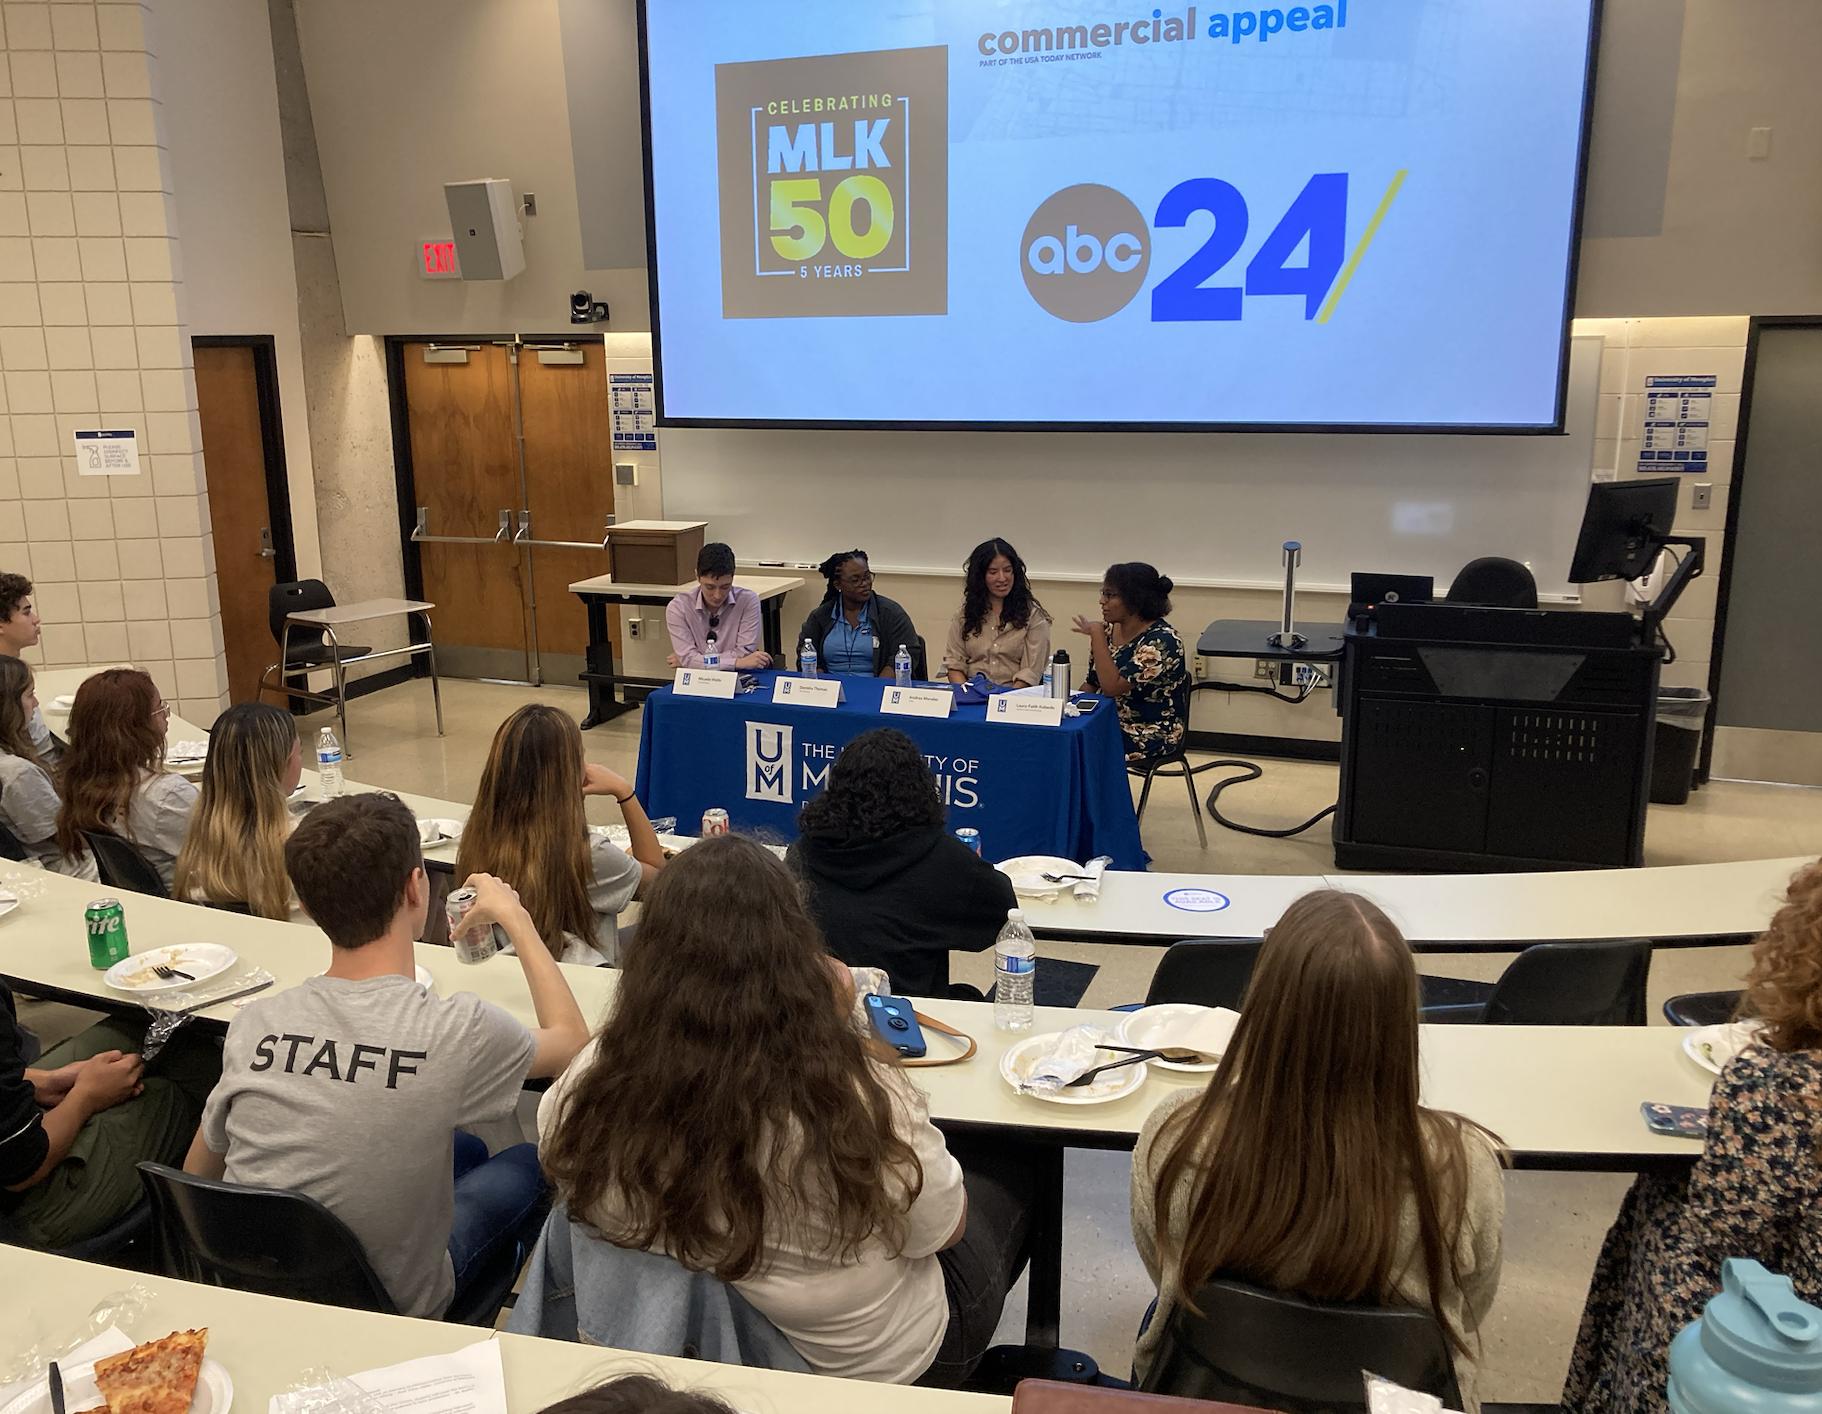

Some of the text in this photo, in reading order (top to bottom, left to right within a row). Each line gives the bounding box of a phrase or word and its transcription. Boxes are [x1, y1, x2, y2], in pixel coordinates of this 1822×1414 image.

[978, 0, 1348, 56] commercial appeal
[1009, 57, 1023, 65] THE
[1025, 56, 1039, 64] USA
[1040, 54, 1065, 63] TODAY
[1065, 51, 1102, 61] NETWORK
[767, 93, 892, 115] CELEBRATING
[767, 118, 892, 173] MLK
[770, 175, 894, 261] 50
[423, 242, 456, 273] EXIT
[1028, 224, 1143, 275] abc
[800, 264, 863, 278] 5 YEARS
[755, 729, 783, 762] U
[802, 742, 835, 759] THE
[755, 761, 783, 796] M
[764, 763, 775, 775] of
[953, 757, 979, 774] OF
[86, 915, 120, 934] rite
[250, 1032, 427, 1089] STAFF
